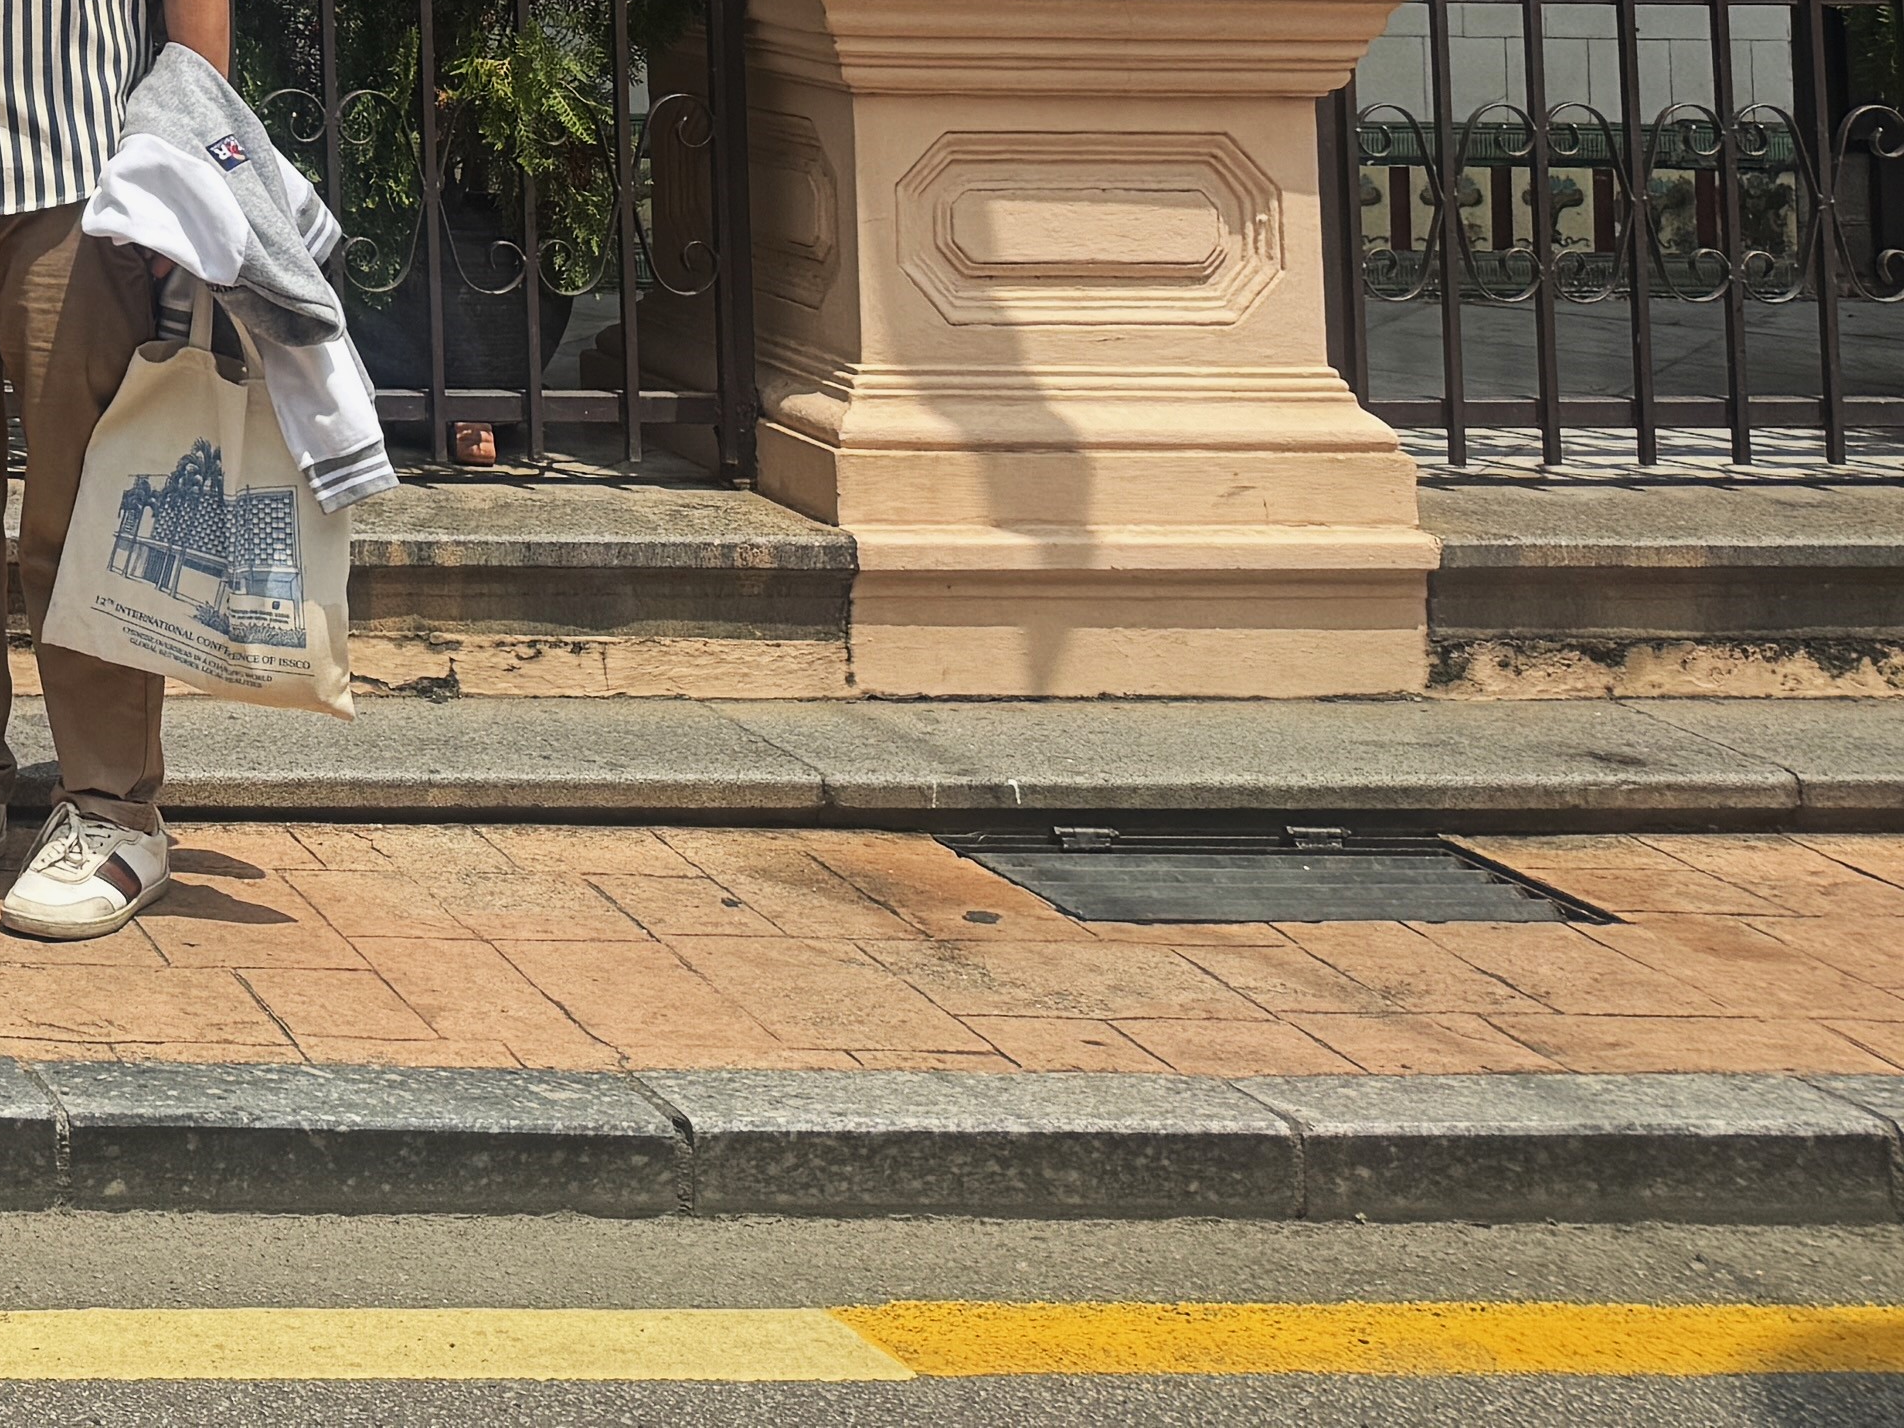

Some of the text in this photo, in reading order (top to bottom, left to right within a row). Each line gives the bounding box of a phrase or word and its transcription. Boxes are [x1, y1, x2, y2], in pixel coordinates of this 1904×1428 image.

[115, 603, 195, 641] INTERNATIONAL
[261, 655, 277, 665] OF
[278, 657, 311, 670] ISSCO
